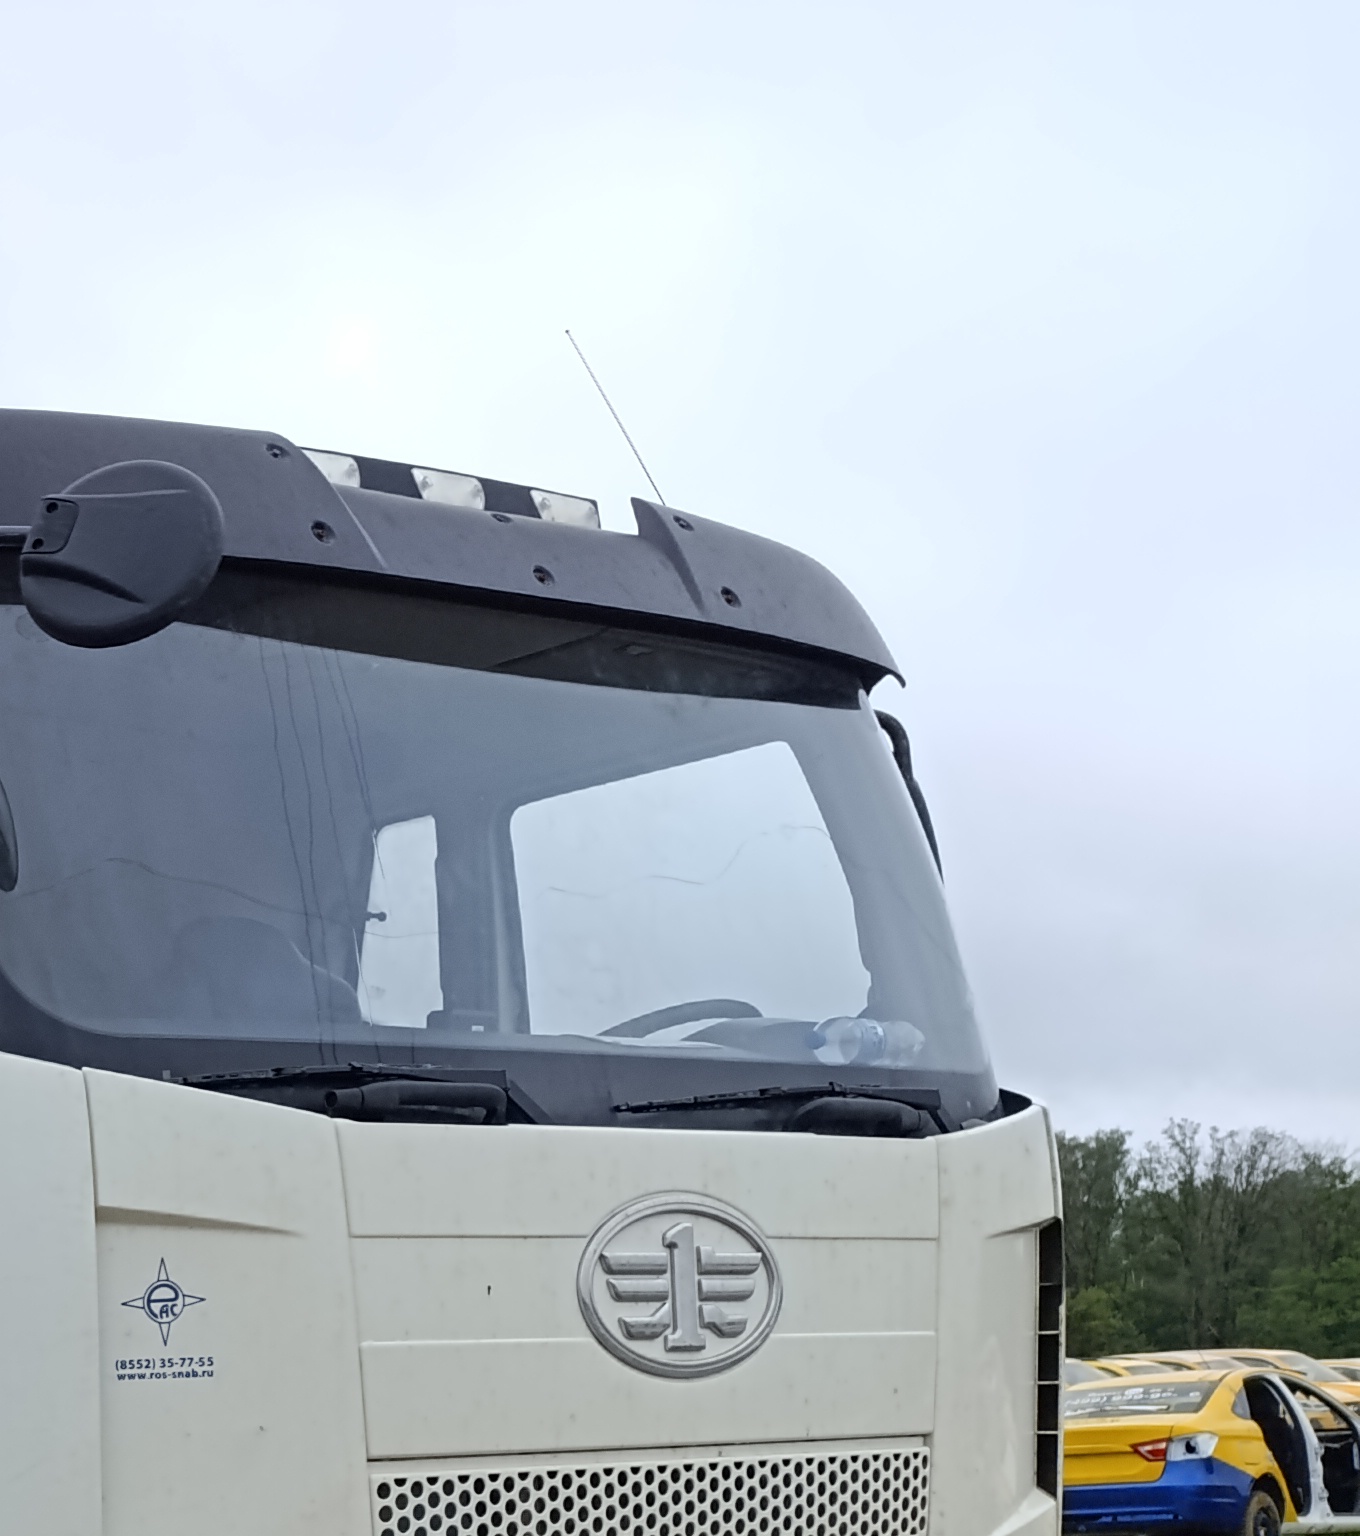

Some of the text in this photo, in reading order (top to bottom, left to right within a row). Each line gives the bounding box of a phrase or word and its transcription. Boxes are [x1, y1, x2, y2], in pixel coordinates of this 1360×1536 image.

[115, 1356, 215, 1372] (8552) 35-77-55
[116, 1368, 215, 1381] www.ros-snab.ru
